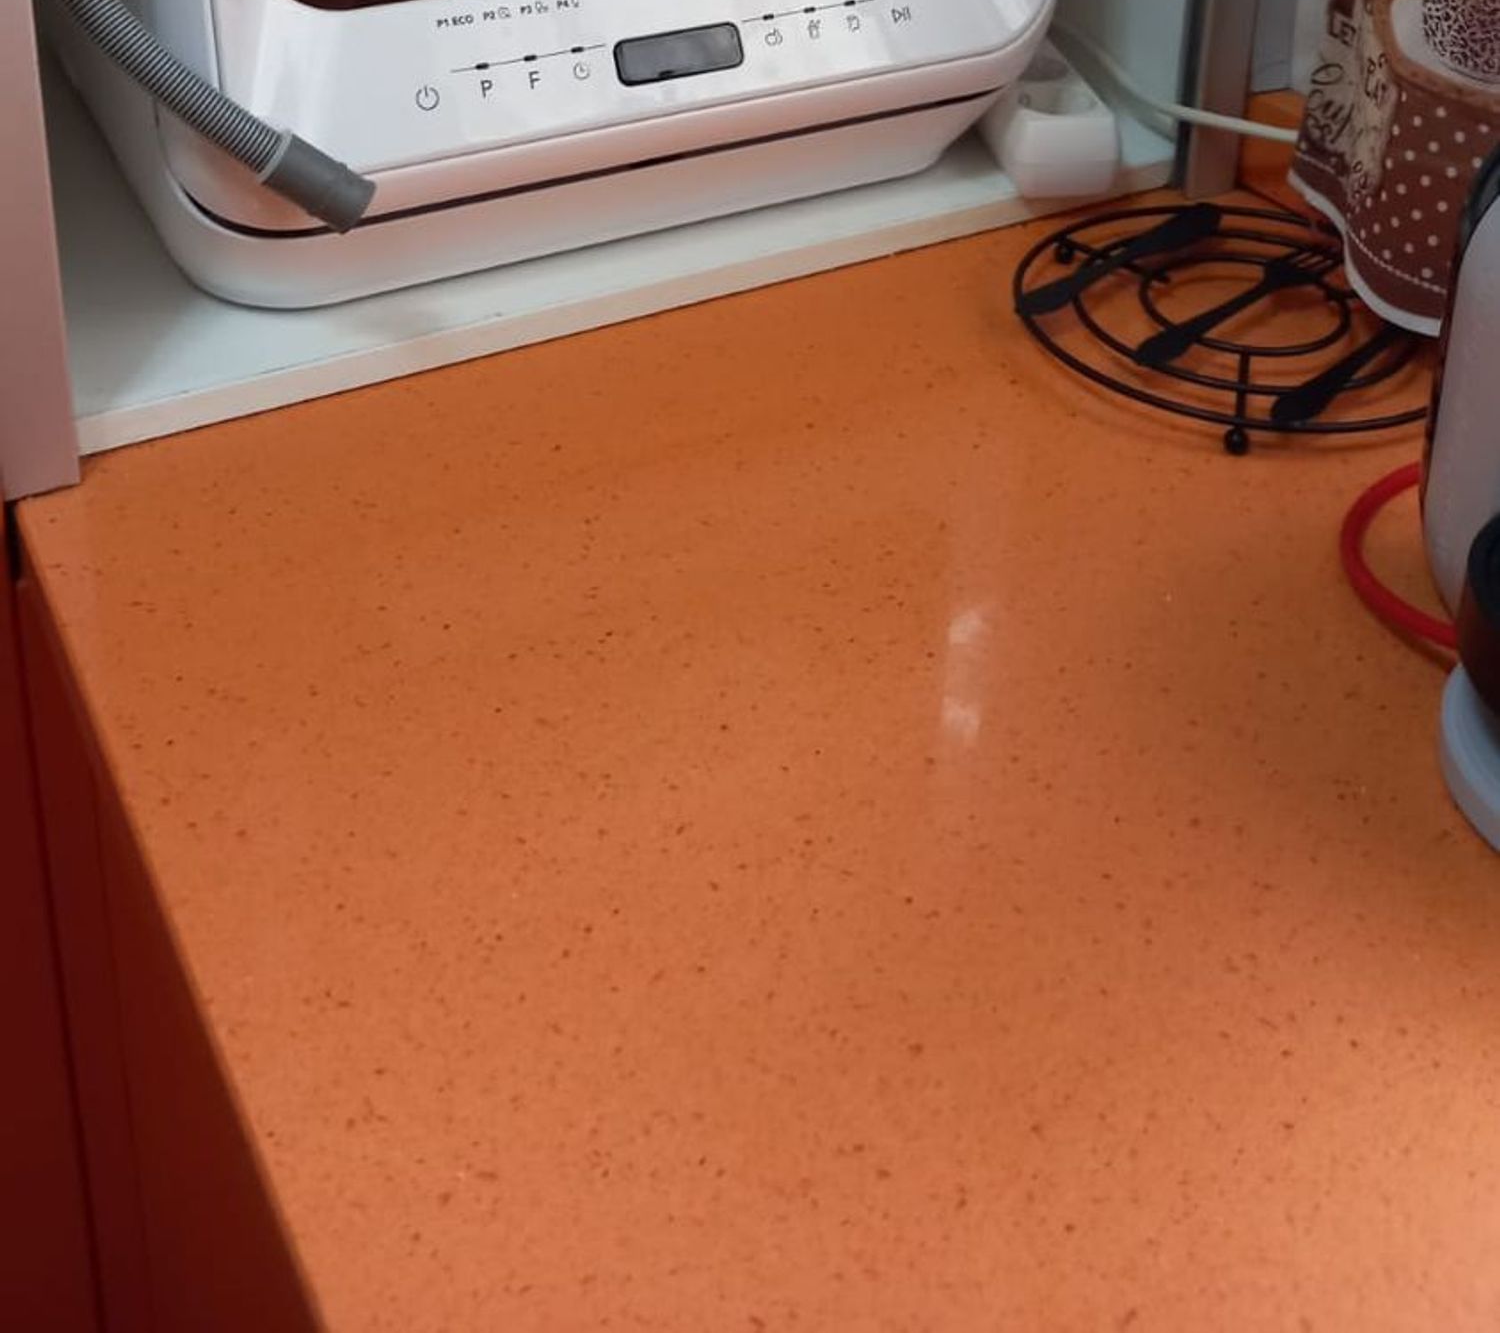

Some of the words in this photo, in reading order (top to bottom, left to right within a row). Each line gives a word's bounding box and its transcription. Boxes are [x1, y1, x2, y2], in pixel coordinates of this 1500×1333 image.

[436, 17, 450, 28] P1
[451, 13, 474, 26] ECO
[482, 10, 496, 21] P2
[480, 79, 493, 99] P
[528, 70, 541, 90] F
